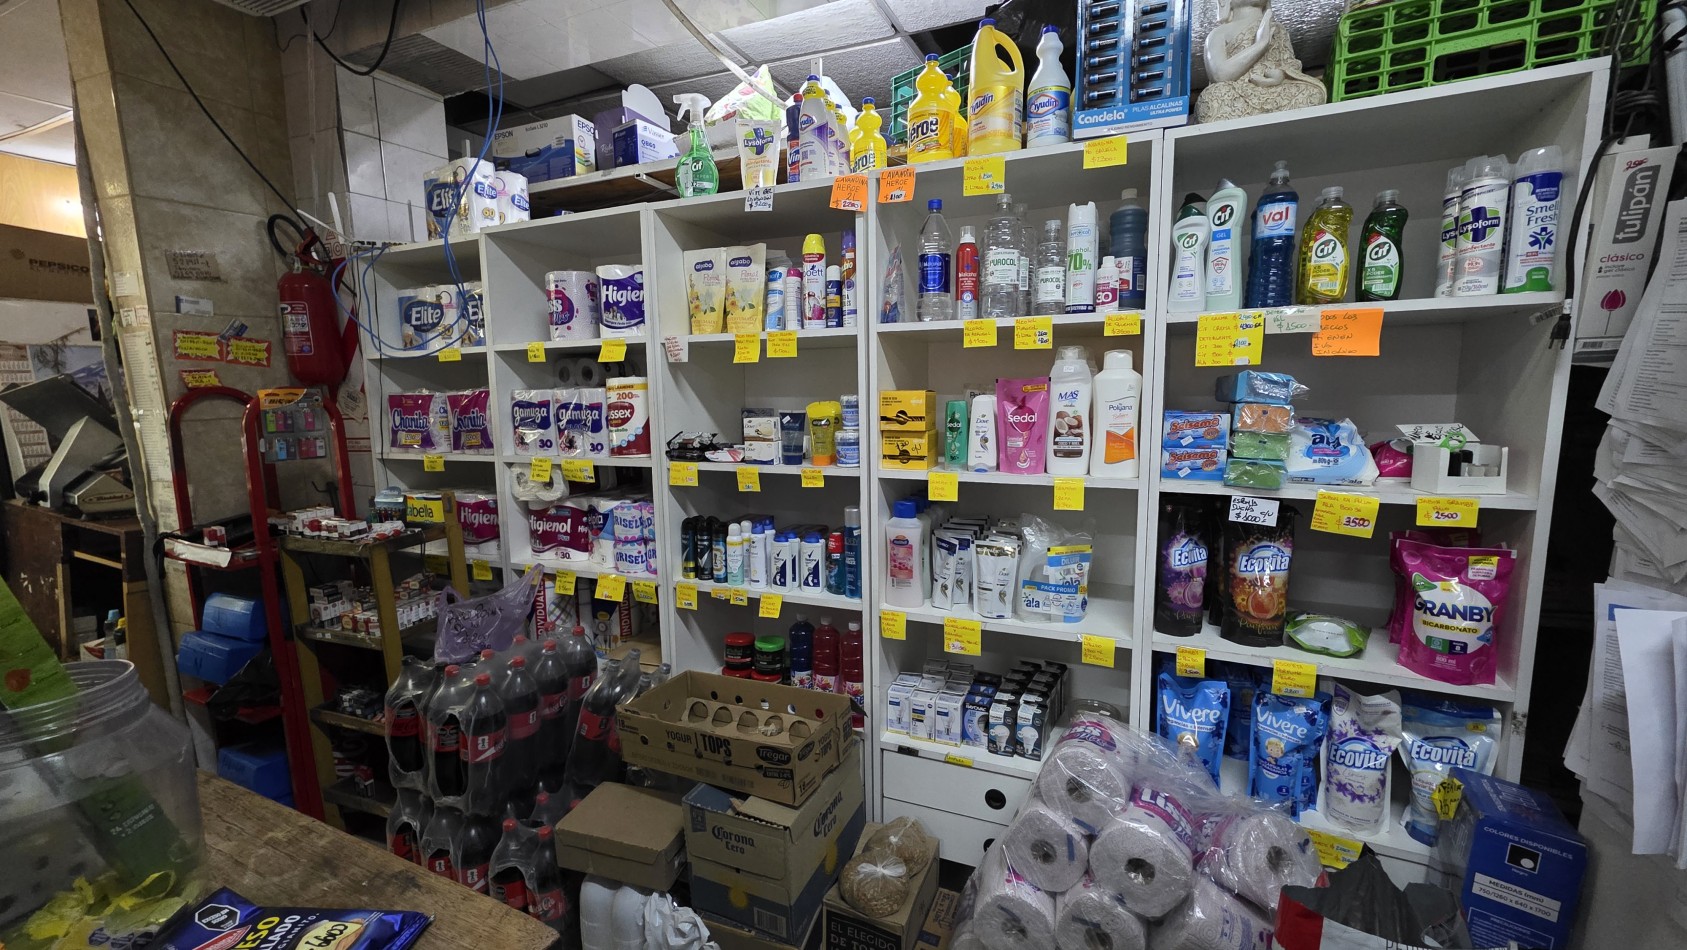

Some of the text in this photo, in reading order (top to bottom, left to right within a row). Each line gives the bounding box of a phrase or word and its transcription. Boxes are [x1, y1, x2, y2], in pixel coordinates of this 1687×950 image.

[1149, 101, 1183, 110] ALCALINAS
[1078, 110, 1125, 124] Candela
[577, 119, 595, 135] EPSO
[909, 117, 939, 143] éroe
[494, 130, 513, 140] EPSON
[744, 136, 773, 147] Lysoform
[692, 160, 703, 171] Cif
[850, 153, 875, 173] éroe
[477, 183, 497, 198] Elite
[432, 187, 456, 210] Elit
[515, 197, 529, 209] Elite
[1615, 170, 1653, 240] tulipán
[482, 207, 496, 216] 60
[1214, 207, 1232, 225] Cif
[1263, 206, 1290, 225] val
[1460, 218, 1499, 233] Lysoform
[1527, 214, 1558, 226] Fresh
[1183, 236, 1198, 247] Cif
[1316, 241, 1335, 257] Cif
[1370, 244, 1390, 260] Cif
[1600, 253, 1645, 263] clásico
[29, 258, 88, 273] PEPSICO
[989, 258, 1016, 267] PUROCOL
[1067, 253, 1092, 272] 70%
[1096, 292, 1112, 303] 30
[411, 306, 441, 325] Elite
[1321, 311, 1339, 320] ODOS
[616, 391, 634, 400] 200
[1058, 389, 1079, 400] MAS
[513, 405, 548, 427] gamuza
[559, 407, 600, 429] gamuza
[608, 408, 632, 418] ssex
[1008, 413, 1038, 423] sedal
[538, 439, 553, 449] 30
[589, 443, 604, 453] 30
[406, 503, 434, 518] abella
[461, 506, 499, 528] Higien
[1434, 512, 1459, 520] 2500
[529, 514, 571, 534] Higienol
[1343, 516, 1371, 527] 3500
[560, 551, 571, 559] 30
[1240, 555, 1290, 572] Ecovita
[1026, 598, 1040, 608] ala
[1414, 592, 1498, 623] GRANBY
[1422, 620, 1478, 634] BICARBONATO
[1163, 694, 1221, 723] Vivere
[1256, 706, 1308, 738] Vivere
[665, 728, 732, 758] YOGUR TOPS
[759, 748, 790, 762] Tregar
[1329, 743, 1388, 770] Ecovita
[1411, 740, 1476, 768] Ecovita
[814, 791, 843, 837] Corona
[711, 824, 756, 848] Corona
[1483, 826, 1573, 860] COLORES DISPONIBLES
[725, 841, 746, 855] Cero
[1488, 880, 1544, 903] MEDIDAS (mm)
[1514, 899, 1528, 909] 640
[1534, 907, 1551, 917] 1700
[235, 916, 280, 950] ESO
[830, 933, 847, 947] DE
[831, 921, 843, 934] EL
[847, 926, 896, 950] ELEGIDO
